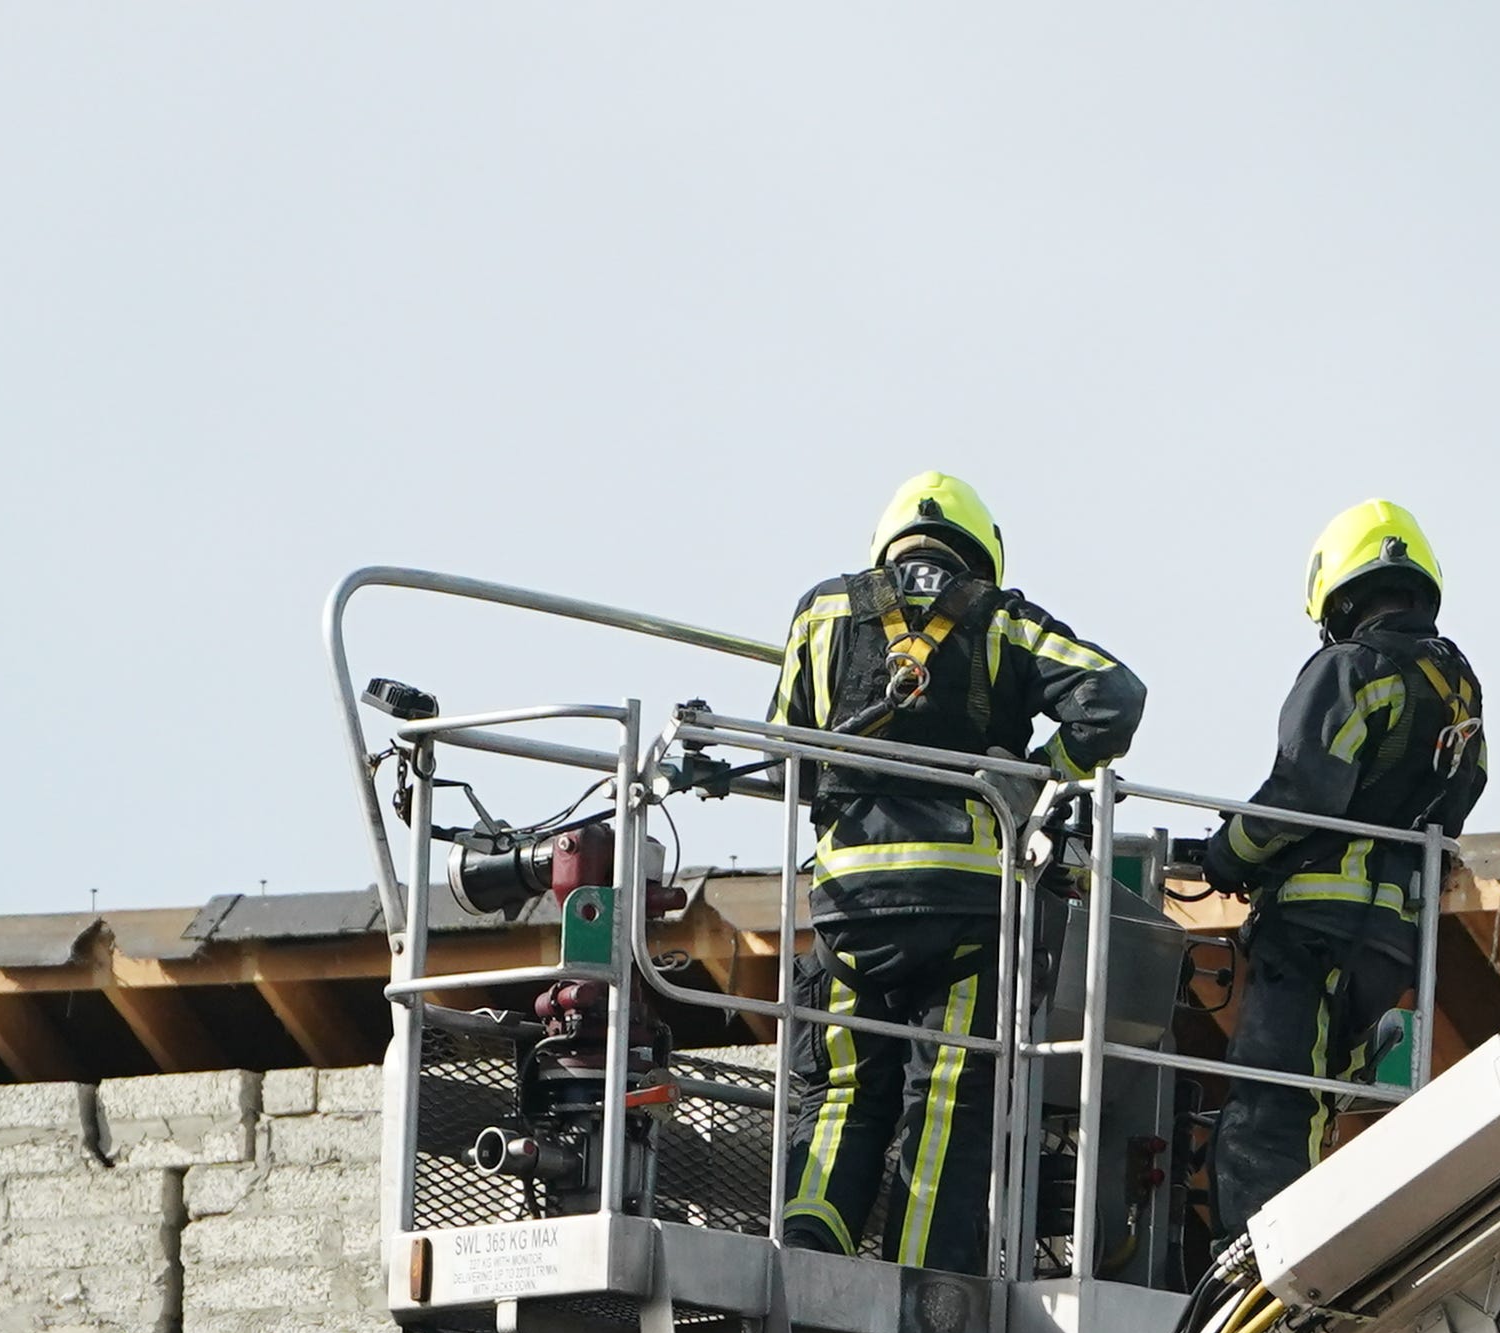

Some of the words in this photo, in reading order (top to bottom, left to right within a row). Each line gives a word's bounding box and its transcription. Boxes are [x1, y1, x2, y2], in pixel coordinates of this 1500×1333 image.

[455, 1233, 481, 1256] SWL
[486, 1231, 506, 1253] 365
[509, 1229, 527, 1250] KG
[531, 1226, 558, 1249] MAX
[493, 1255, 510, 1267] WITH
[512, 1252, 543, 1265] MONITOR
